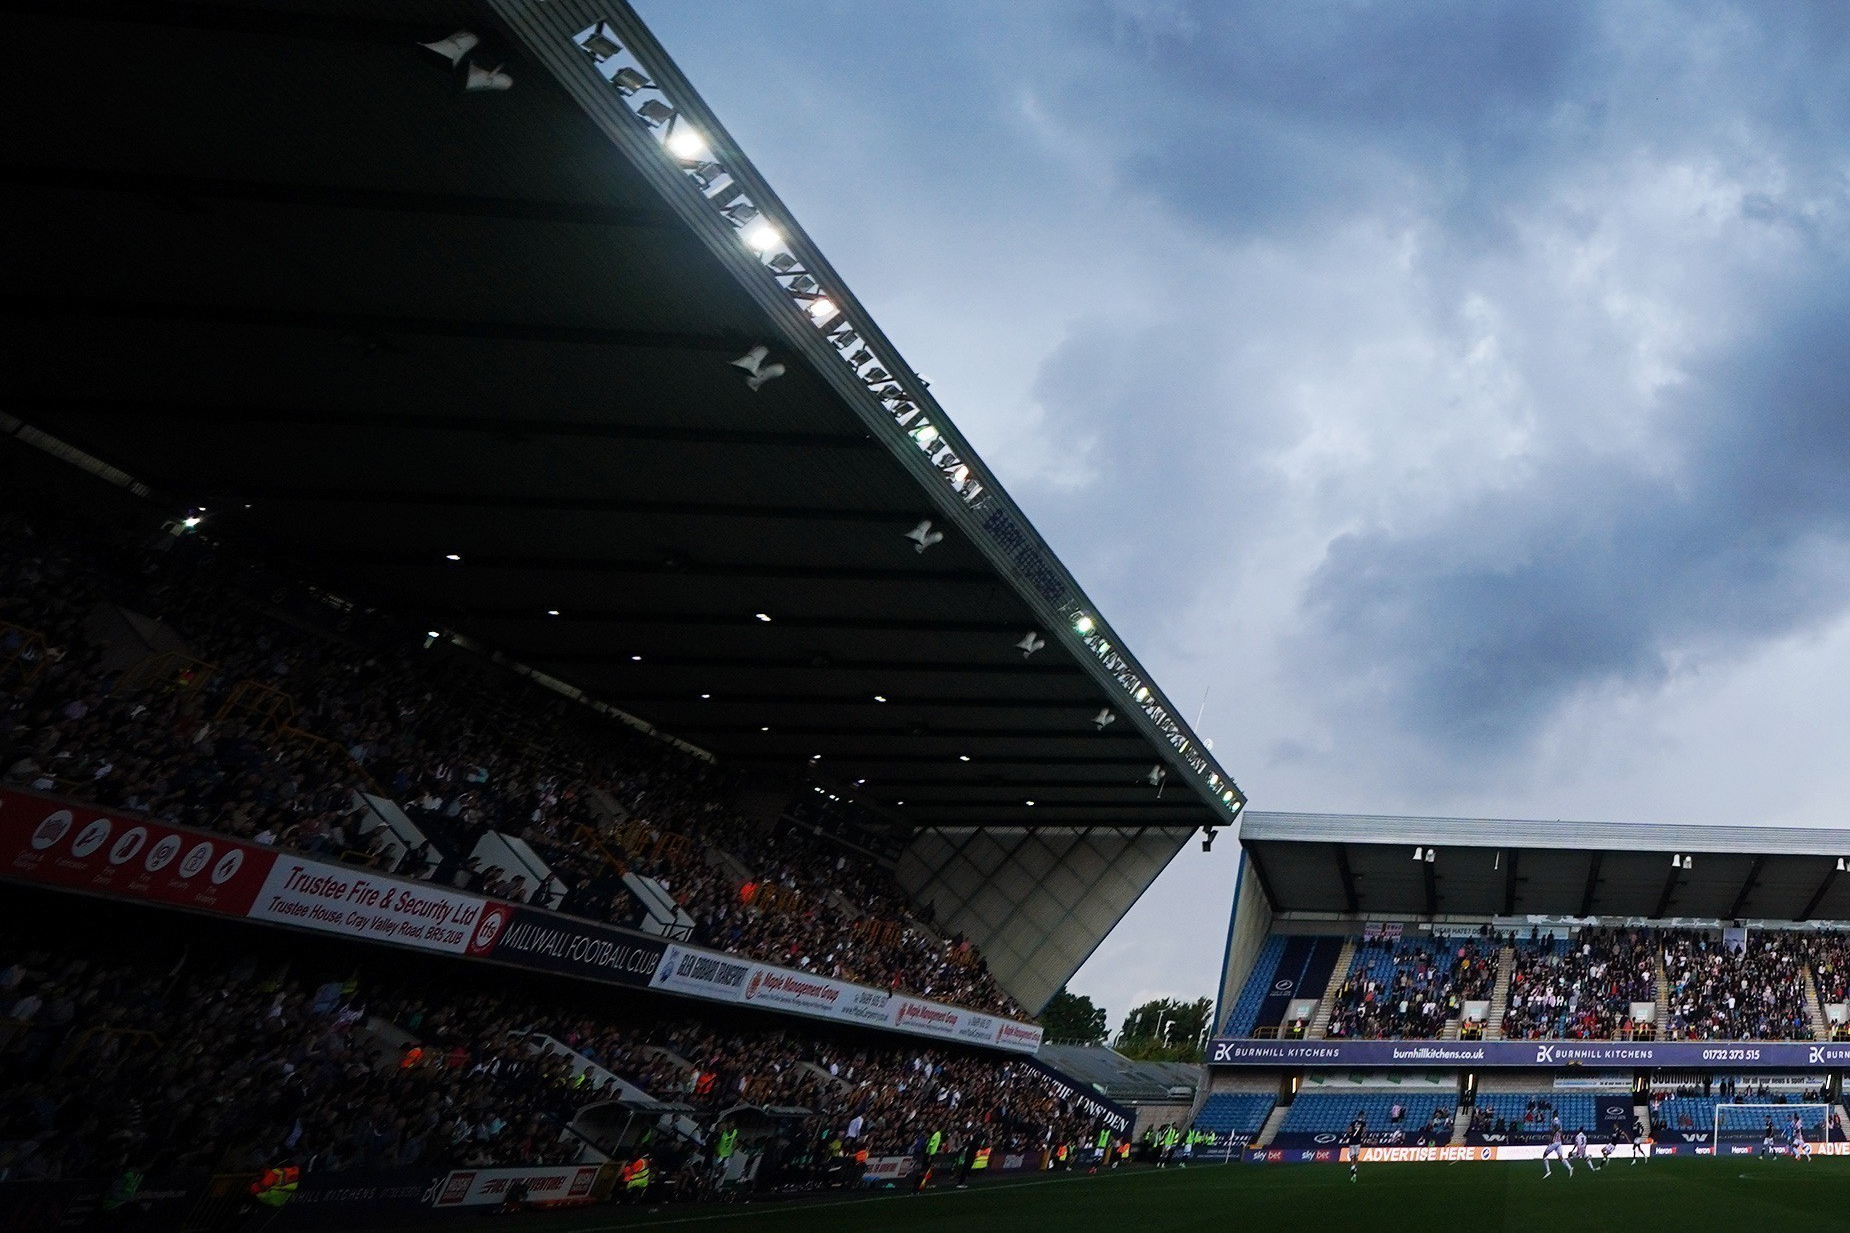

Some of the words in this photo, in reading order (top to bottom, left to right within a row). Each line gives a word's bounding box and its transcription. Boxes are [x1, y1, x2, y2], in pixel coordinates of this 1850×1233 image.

[284, 866, 347, 899] Trustee
[348, 880, 377, 906] Fire
[379, 888, 394, 910] &
[394, 891, 454, 925] Security
[451, 903, 480, 926] Ltd
[267, 896, 307, 917] Trustee
[308, 905, 343, 924] House,
[346, 911, 370, 932] Cray
[372, 916, 399, 937] Valley
[399, 921, 423, 938] Road,
[424, 926, 445, 943] BR5
[444, 930, 464, 945] 2UB
[499, 921, 570, 957] MILLWALL
[566, 935, 628, 969] FOOTBALL
[626, 948, 660, 974] CLUB
[1235, 1047, 1284, 1057] BURNHILL
[1287, 1048, 1339, 1057] KITCHENS
[1393, 1048, 1484, 1061] burnhillkitchens.co.uk
[1555, 1050, 1601, 1059] BURNHILL
[1604, 1050, 1653, 1059] KITCHENS
[1702, 1049, 1728, 1060] 01732
[1728, 1049, 1744, 1060] 373
[1745, 1049, 1760, 1060] 515
[1074, 1094, 1106, 1118] IONS'
[1103, 1111, 1129, 1133] DEN
[1252, 1150, 1266, 1161] sky
[1267, 1150, 1282, 1159] bet
[1301, 1150, 1314, 1161] sky
[1315, 1150, 1330, 1159] bet
[1362, 1147, 1437, 1161] ADVERTISE
[1439, 1147, 1476, 1160] HERE
